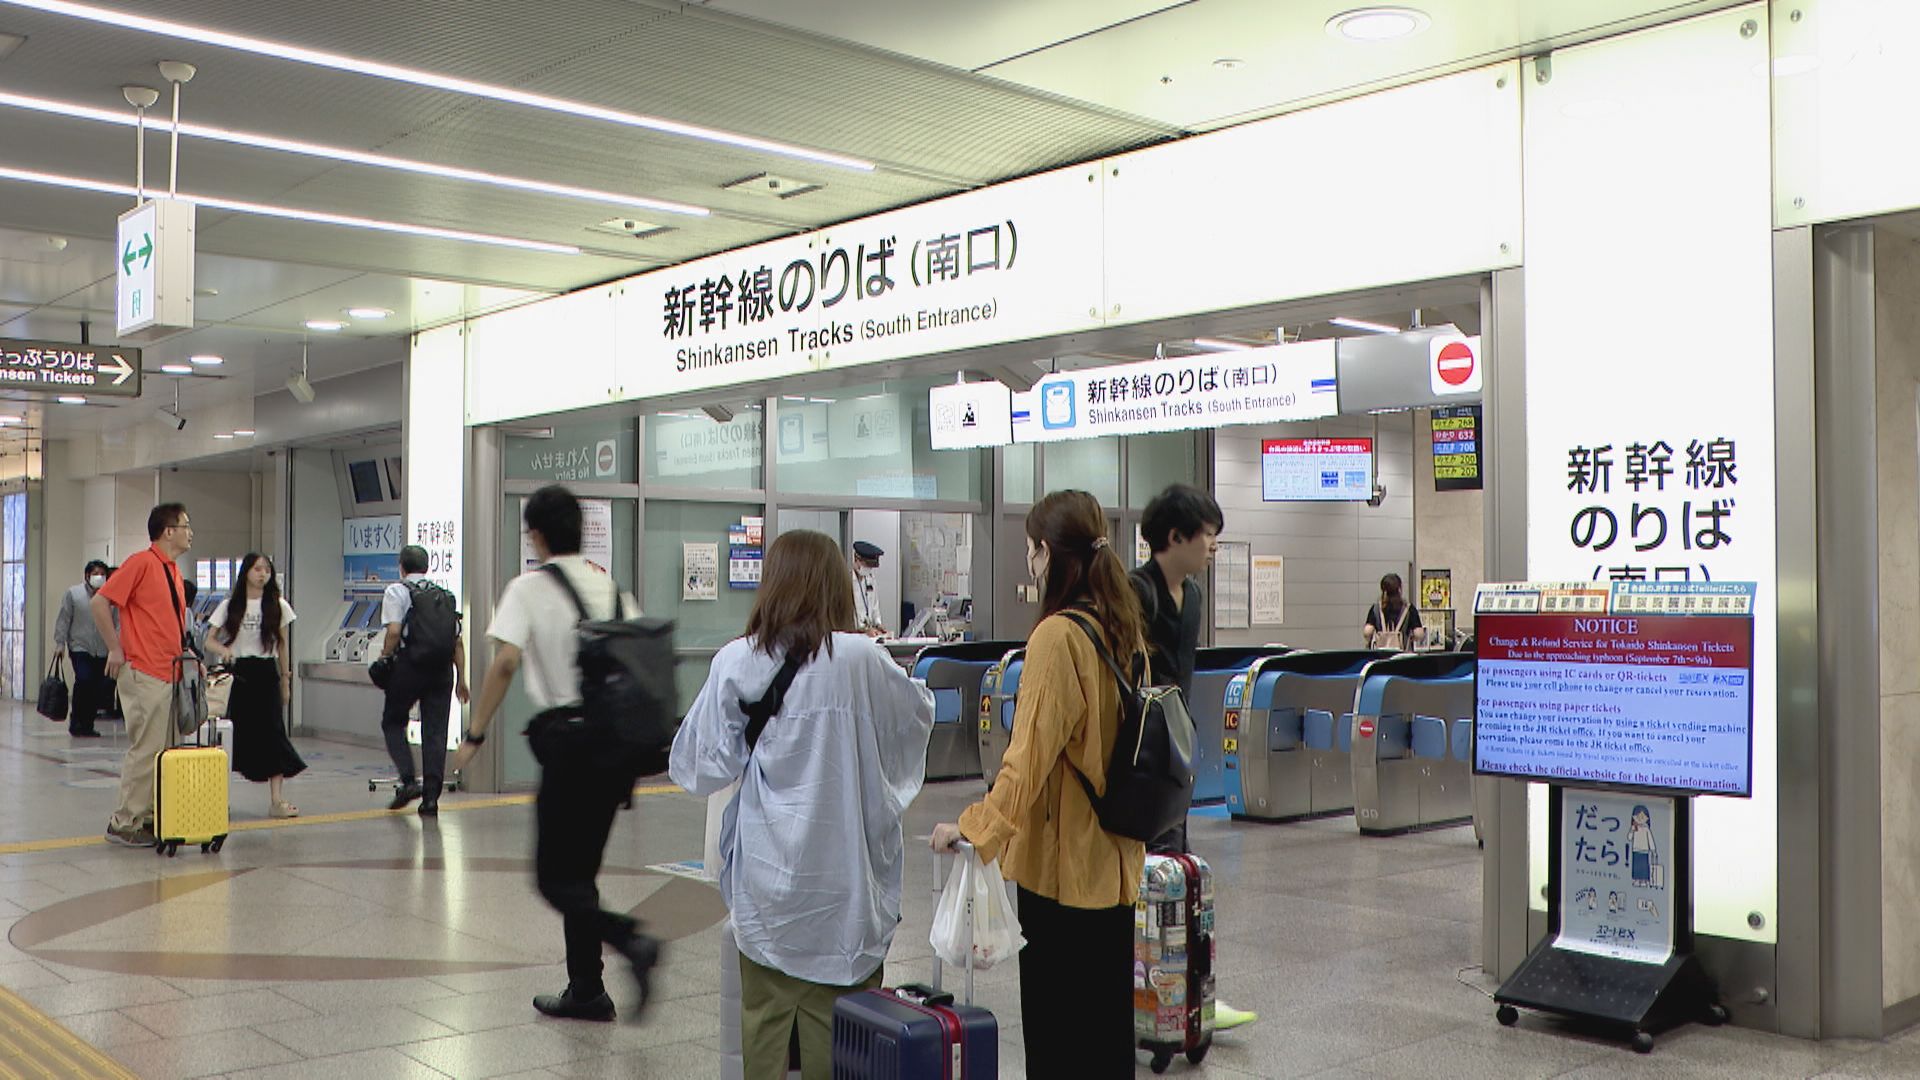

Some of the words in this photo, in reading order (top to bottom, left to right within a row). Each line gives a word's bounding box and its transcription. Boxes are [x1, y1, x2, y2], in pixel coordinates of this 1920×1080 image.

[663, 220, 1018, 340] 新幹線のりば（南口）
[676, 337, 778, 372] Shinkansen
[787, 321, 853, 352] Tracks
[860, 316, 912, 342] (South
[918, 297, 998, 331] Entrance)
[0, 348, 96, 370] っぷうりば
[40, 369, 96, 385] Tickets
[1087, 363, 1278, 404] 新幹線のりば（南口）
[1088, 403, 1157, 425] Shinkansen
[1160, 400, 1203, 418] Tracks
[1207, 397, 1242, 413] (South
[1244, 392, 1296, 411] Entrance)
[1458, 430, 1475, 440] 632
[1459, 443, 1475, 452] 700
[1460, 455, 1476, 464] 200
[1567, 437, 1738, 494] 新幹線
[1461, 467, 1476, 476] 202
[416, 520, 455, 545] 新幹線
[1570, 498, 1736, 552] のりば
[350, 522, 402, 550] 「いますぐ」
[1574, 618, 1639, 635] NOTICE
[1489, 637, 1519, 648] Change
[1521, 637, 1529, 647] &
[1531, 637, 1560, 648] Refund
[1562, 638, 1593, 649] Service
[1596, 639, 1608, 649] for
[1611, 640, 1645, 650] Tokaido
[1647, 640, 1698, 652] Shinkansen
[1701, 641, 1735, 653] Tickets
[1508, 650, 1521, 659] Due
[1524, 650, 1532, 658] to
[1533, 650, 1544, 659] the
[1546, 651, 1591, 663] approaching
[1592, 653, 1623, 663] typhoon
[1625, 653, 1670, 665] (September
[1479, 665, 1489, 675] or
[1492, 667, 1537, 678] passengers
[1539, 667, 1562, 679] using
[1564, 668, 1576, 679] IC
[1578, 669, 1602, 680] cards
[1605, 671, 1616, 681] or
[1617, 671, 1667, 683] QR-tickets
[1229, 684, 1242, 697] IC
[1486, 678, 1509, 689] Please
[1510, 680, 1522, 689] use
[1523, 680, 1542, 691] your
[1543, 680, 1557, 690] cell
[1559, 680, 1583, 693] phone
[1584, 683, 1593, 692] to
[1594, 683, 1622, 694] change
[1624, 686, 1633, 694] or
[1635, 685, 1662, 695] cancel
[1663, 687, 1684, 697] your
[1686, 688, 1739, 699] reservation.
[1479, 698, 1490, 707] or
[1492, 699, 1537, 711] passengers
[1539, 699, 1562, 712] using
[1564, 702, 1590, 714] paper
[1592, 702, 1621, 714] tickets
[1226, 712, 1238, 728] IC
[1480, 709, 1494, 719] You
[1495, 711, 1508, 719] can
[1510, 710, 1536, 721] change
[1538, 712, 1556, 724] your
[1557, 714, 1602, 724] reservation
[1603, 717, 1613, 728] by
[1615, 717, 1638, 729] using
[1646, 719, 1670, 730] ticket
[1672, 721, 1707, 732] vending
[1708, 723, 1746, 735] machine
[1484, 722, 1511, 732] coming
[1513, 722, 1521, 731] to
[1522, 722, 1534, 733] the
[1536, 723, 1547, 733] JR
[1549, 724, 1570, 735] ticket
[1598, 728, 1606, 737] If
[1607, 730, 1622, 740] you
[1624, 731, 1645, 740] want
[1647, 731, 1656, 741] to
[1657, 732, 1684, 743] cancel
[1686, 735, 1706, 745] your
[1519, 735, 1542, 747] please
[1544, 736, 1564, 746] come
[1566, 738, 1574, 747] to
[1576, 738, 1588, 748] the
[1590, 740, 1602, 749] JR
[1604, 741, 1627, 752] ticket
[1481, 759, 1507, 771] Please
[1509, 760, 1533, 773] check
[1535, 762, 1549, 775] the
[1550, 764, 1581, 777] official
[1583, 766, 1615, 779] website
[1619, 769, 1632, 781] for
[1634, 771, 1649, 783] the
[1651, 772, 1677, 785] latest
[1679, 774, 1741, 790] information.
[1575, 804, 1621, 832] だっ
[1575, 836, 1630, 867] たら！
